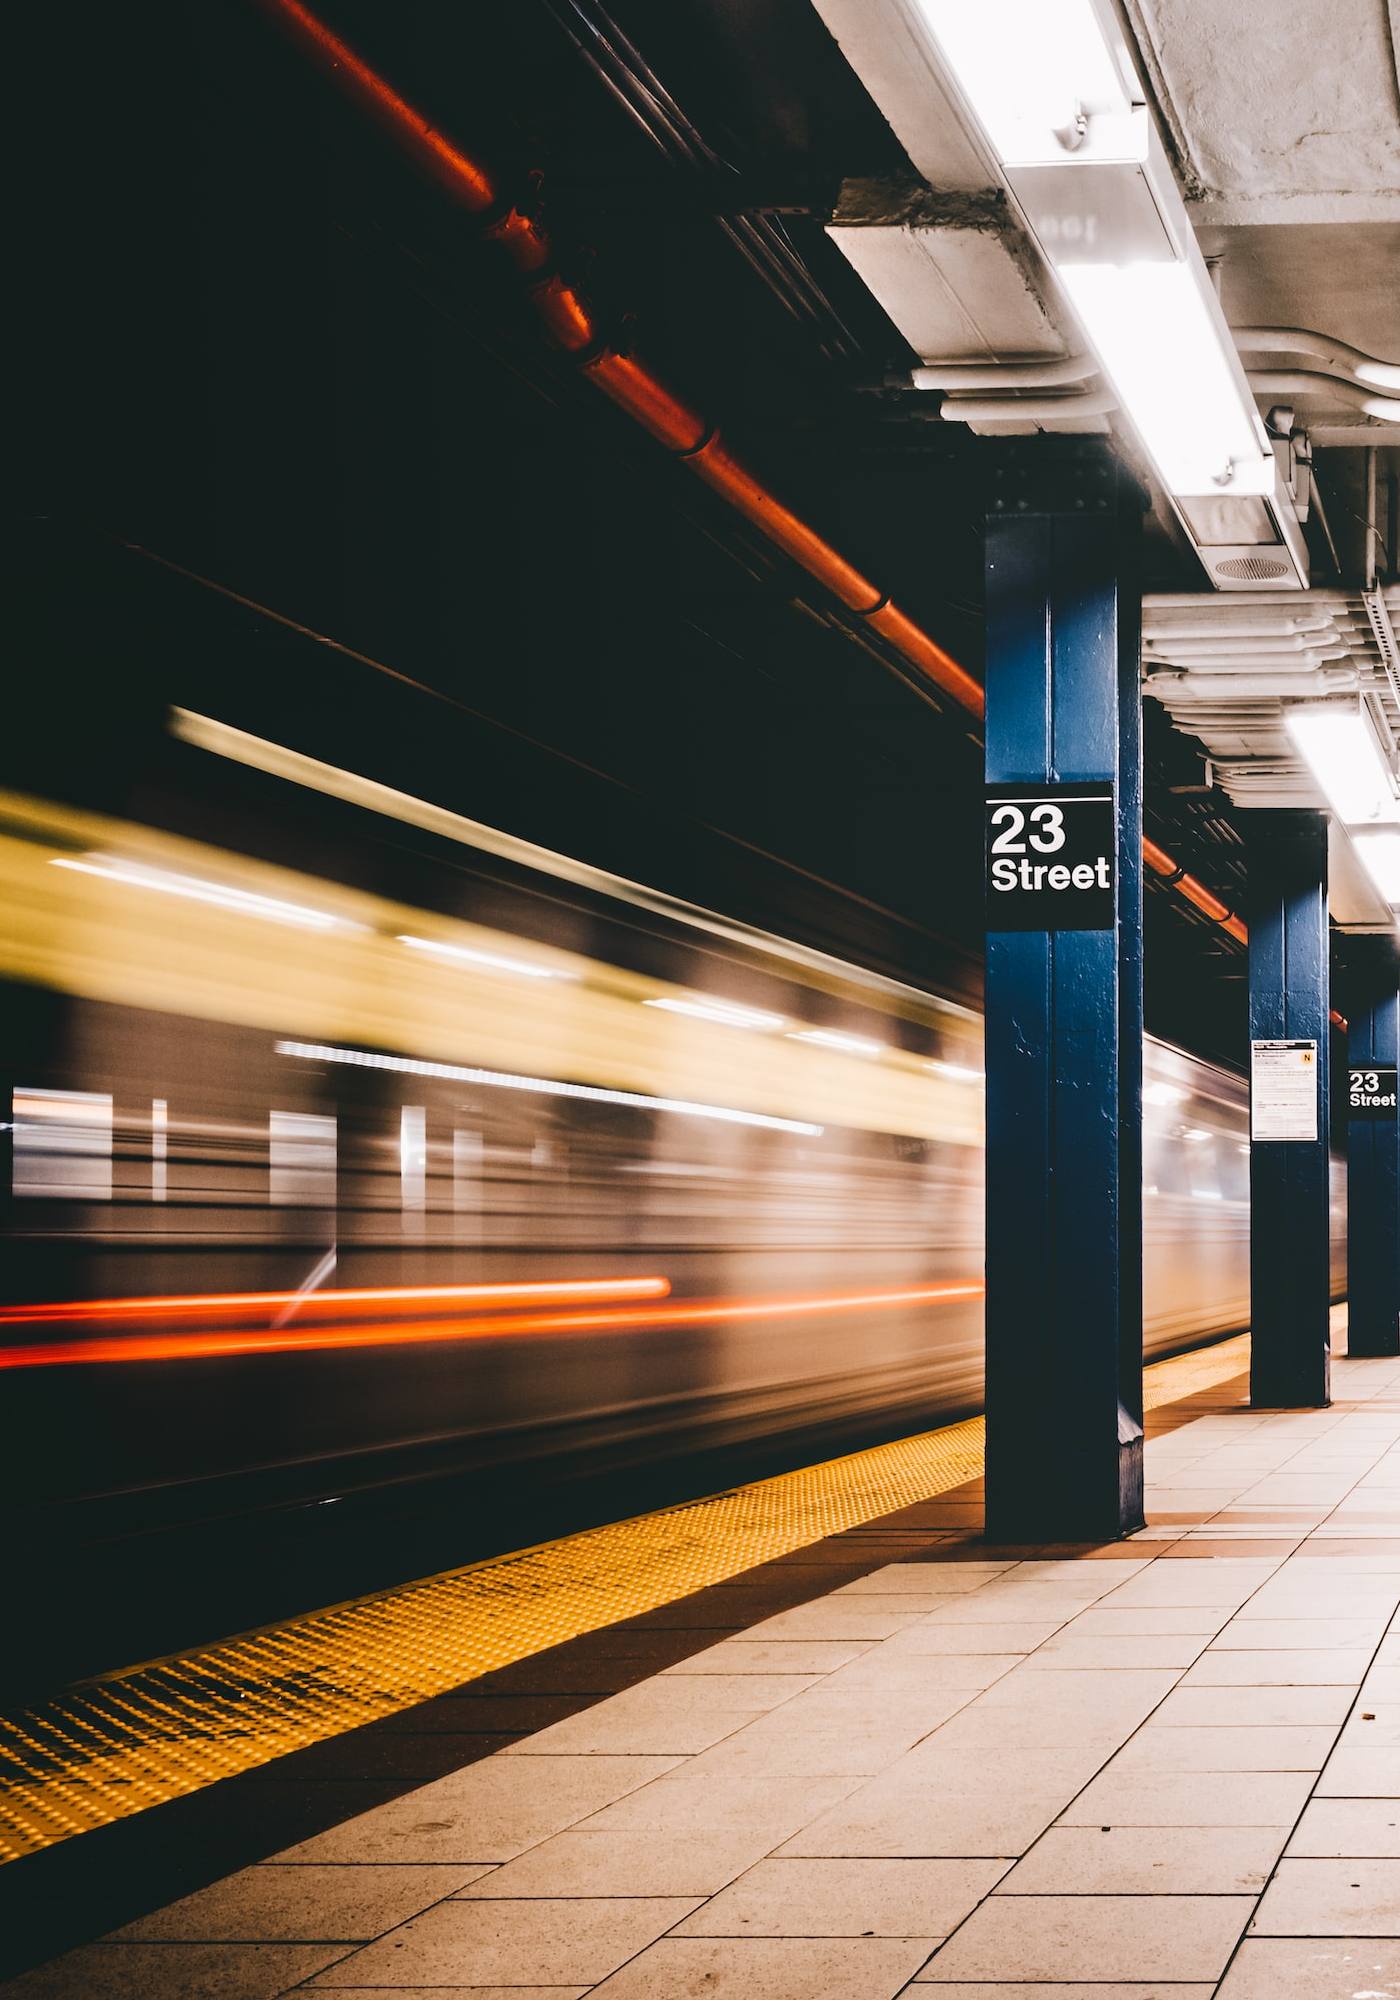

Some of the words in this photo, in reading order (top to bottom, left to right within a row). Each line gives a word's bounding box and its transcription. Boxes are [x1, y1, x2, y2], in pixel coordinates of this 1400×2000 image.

[991, 804, 1066, 854] 23
[991, 857, 1111, 891] Street
[1350, 1073, 1379, 1092] 23
[1350, 1093, 1396, 1107] Street
